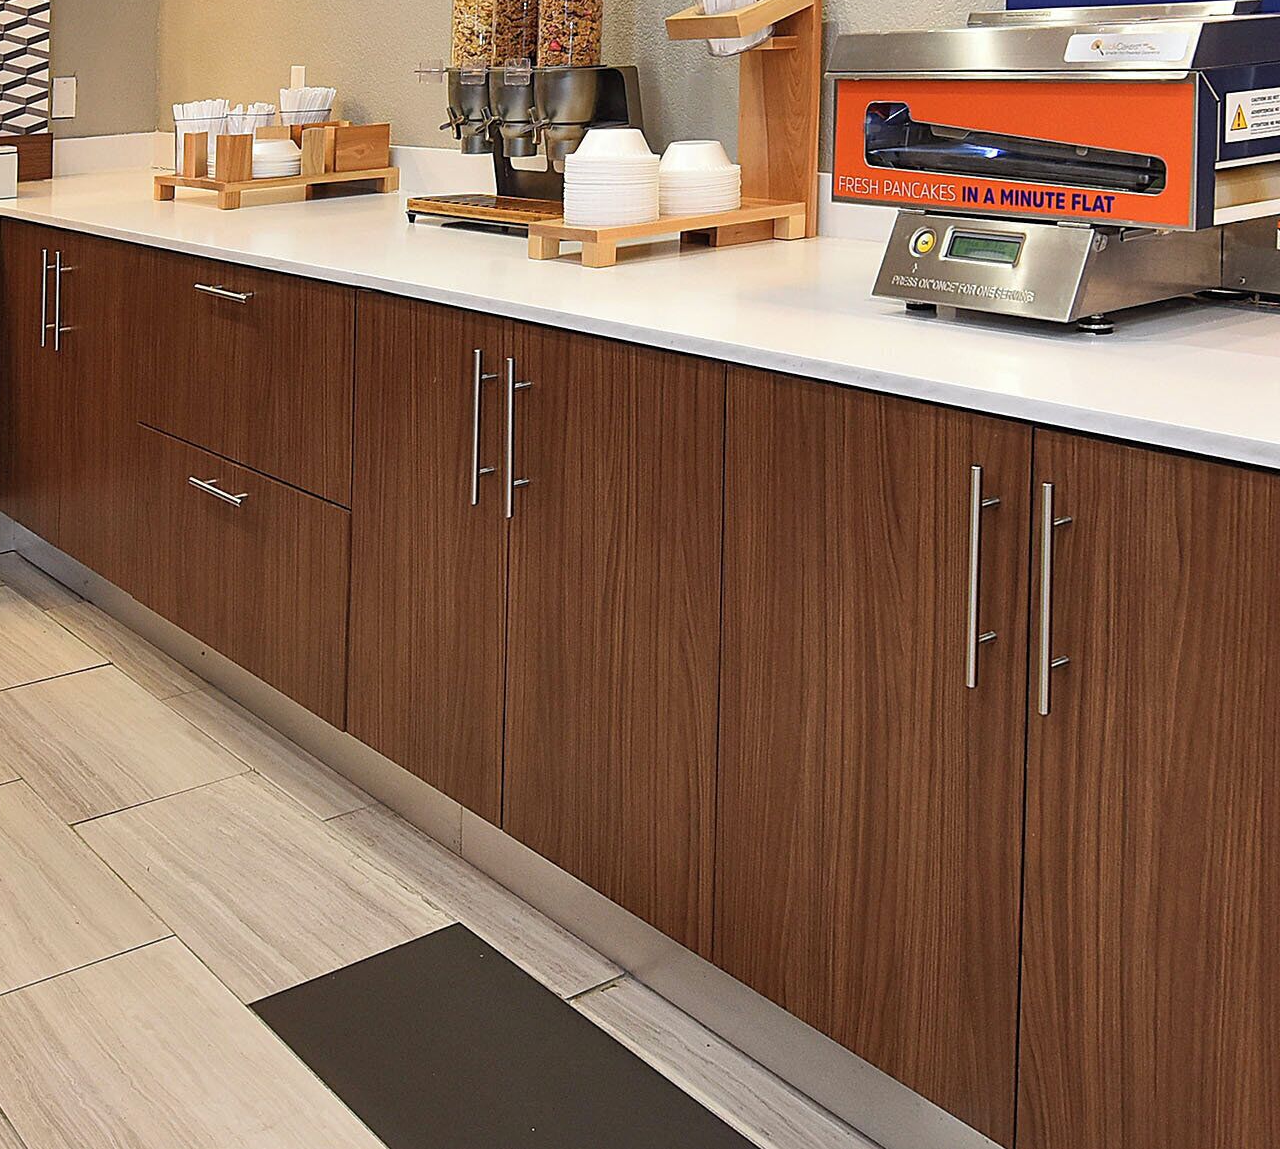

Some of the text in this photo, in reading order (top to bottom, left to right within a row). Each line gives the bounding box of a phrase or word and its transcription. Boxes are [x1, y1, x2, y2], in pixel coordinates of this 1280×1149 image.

[838, 176, 1115, 214] FRESH PANCAKES IN A MINUTE FLAT
[891, 275, 918, 288] PRESS
[959, 282, 977, 296] FOR
[977, 285, 995, 299] ONE
